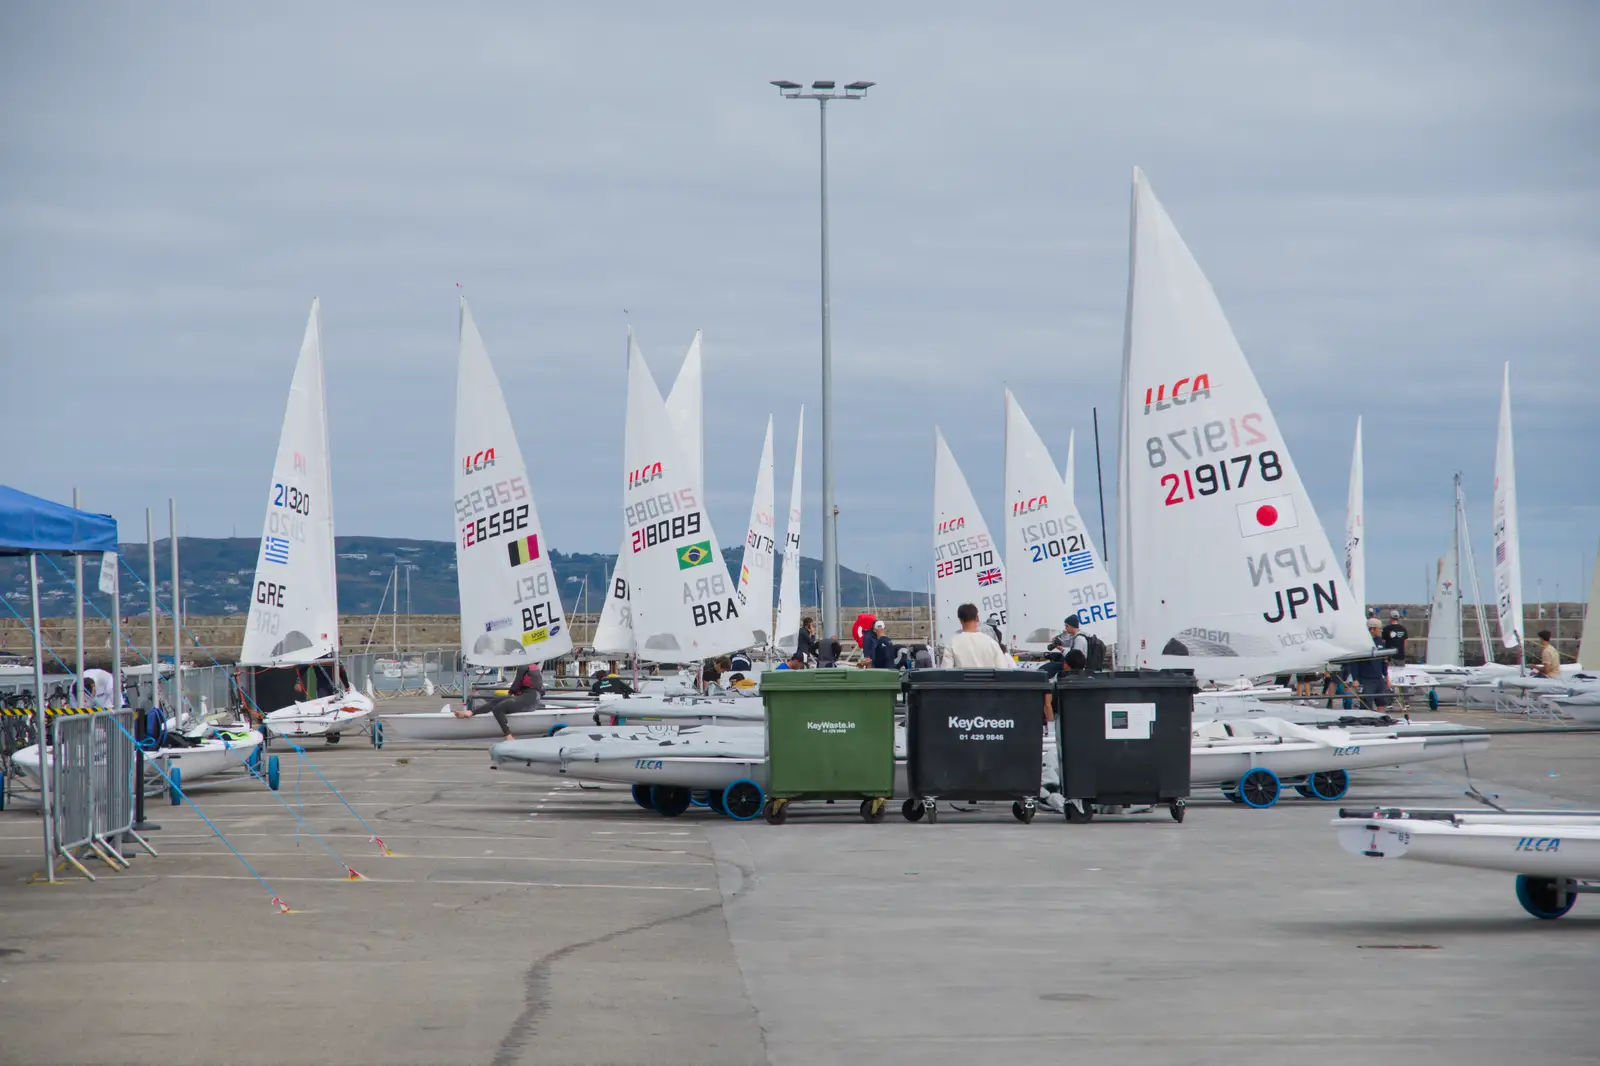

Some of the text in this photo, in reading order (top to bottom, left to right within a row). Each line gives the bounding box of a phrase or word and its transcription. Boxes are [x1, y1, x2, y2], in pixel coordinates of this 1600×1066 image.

[1144, 373, 1211, 415] ILCA
[629, 461, 662, 490] ILCA
[1161, 450, 1283, 506] 219178
[1013, 495, 1048, 517] ILCA
[632, 512, 700, 553] 218089
[938, 517, 965, 535] ILCA
[1030, 533, 1086, 563] 210121
[937, 550, 993, 578] 223070
[256, 581, 287, 608] GRE
[1263, 580, 1340, 623] JPN
[521, 601, 560, 631] BEL
[692, 598, 739, 627] BRA
[1077, 601, 1118, 625] GRE
[807, 721, 856, 731] KeyWaste.ie
[948, 716, 1014, 731] KeyGreen
[634, 759, 663, 770] ILCA
[1516, 836, 1561, 852] ILCA
